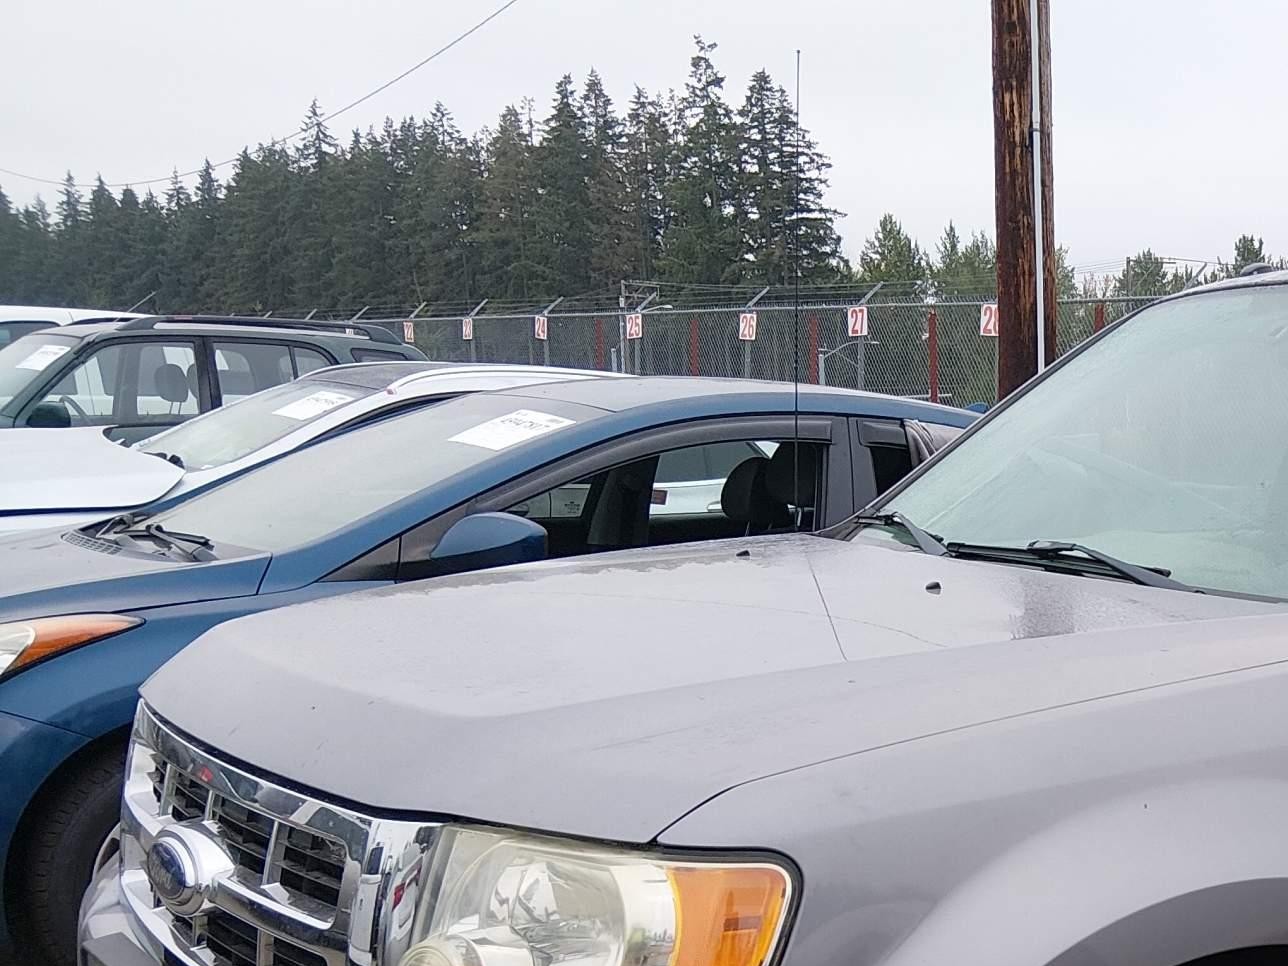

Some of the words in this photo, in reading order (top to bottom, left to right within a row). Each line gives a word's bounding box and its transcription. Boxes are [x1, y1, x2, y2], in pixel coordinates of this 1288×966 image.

[405, 322, 412, 340] 22
[464, 320, 471, 338] 23
[537, 317, 545, 337] 24
[627, 315, 640, 337] 25
[741, 316, 754, 338] 26
[851, 309, 864, 334] 27
